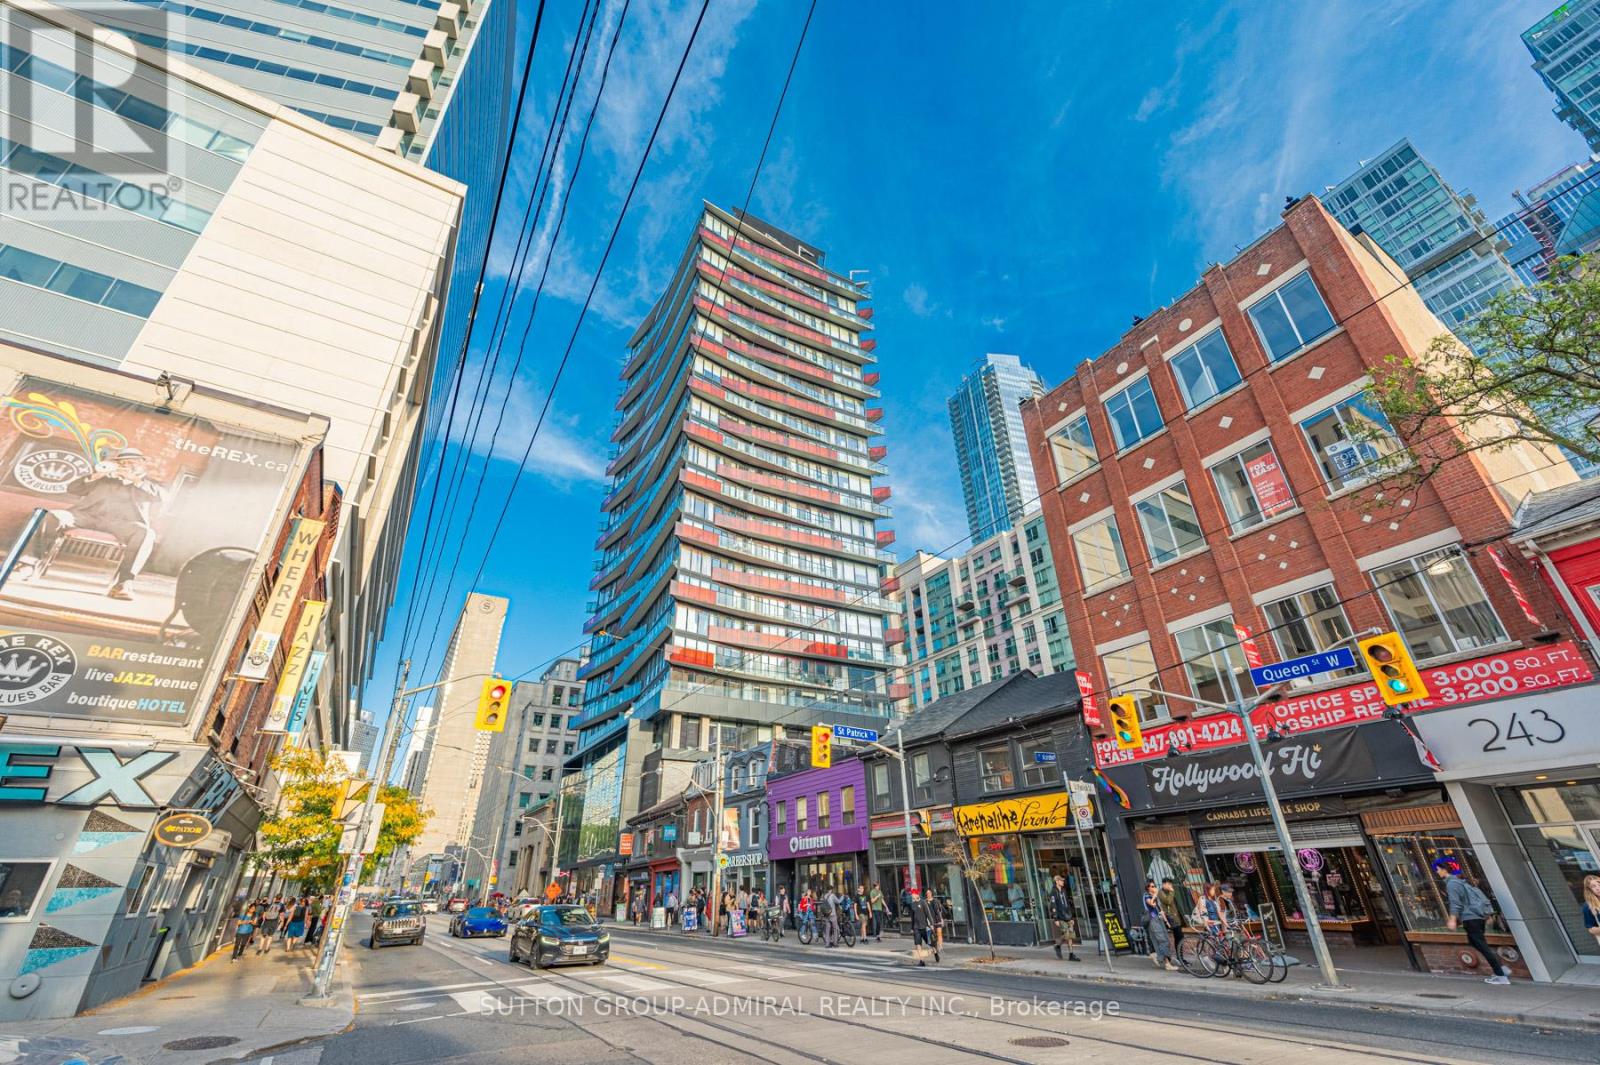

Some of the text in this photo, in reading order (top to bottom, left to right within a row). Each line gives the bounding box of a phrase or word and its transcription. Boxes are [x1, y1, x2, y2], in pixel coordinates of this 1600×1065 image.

[174, 437, 290, 473] theREX.ca
[269, 530, 318, 619] WHERE
[35, 638, 72, 667] REX
[285, 614, 314, 677] JAZZ
[39, 675, 66, 694] BAR
[1262, 654, 1340, 682] Queen St W
[293, 660, 319, 722] LIVES
[1274, 693, 1345, 719] OFFICE
[1432, 659, 1510, 687] 3,000
[1440, 676, 1519, 702] 3,200
[837, 726, 845, 736] St
[846, 728, 869, 739] Patrick
[1096, 740, 1119, 753] FOR
[1141, 718, 1242, 754] 647-891-4224
[1467, 709, 1566, 752] 243
[1098, 749, 1135, 765] LEASE
[1152, 744, 1322, 796] Hollywood Hi
[956, 801, 1067, 835] Adrenaline Toronto
[1206, 802, 1321, 821] CANNABIS LIFESLE SHOP
